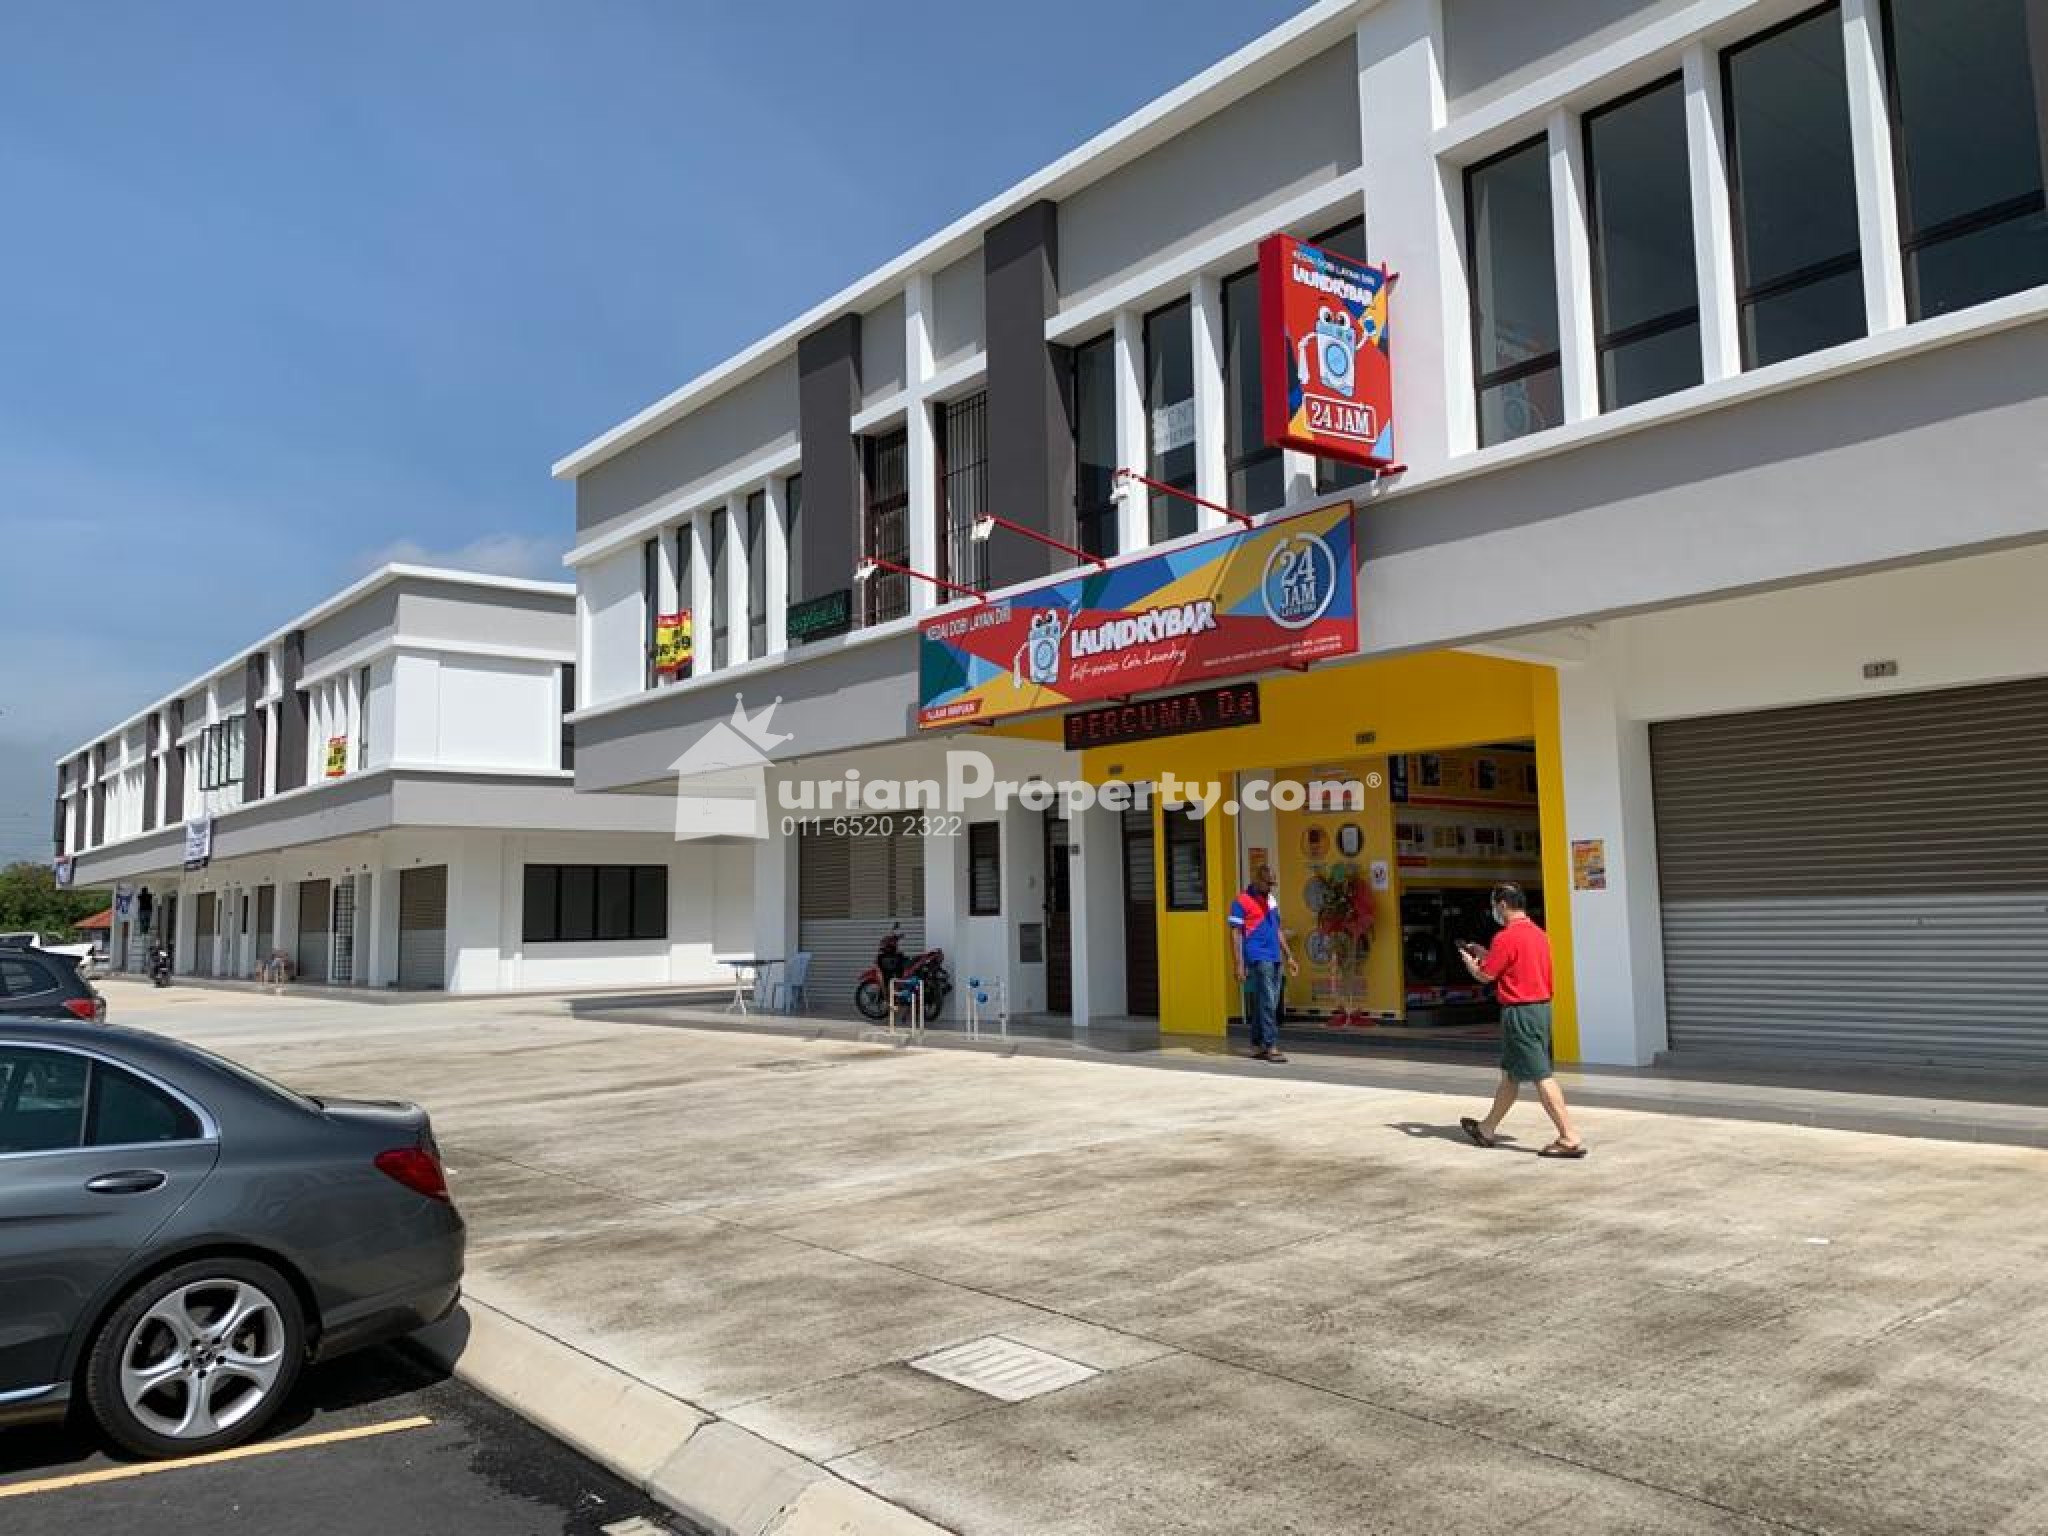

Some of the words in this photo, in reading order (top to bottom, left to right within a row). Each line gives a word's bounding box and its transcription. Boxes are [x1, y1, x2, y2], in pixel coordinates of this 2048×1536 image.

[1311, 401, 1333, 428] 24
[1335, 404, 1371, 435] JAM
[1280, 545, 1316, 588] 24
[1281, 582, 1316, 611] JAM
[1071, 600, 1217, 659] LAUNDRYBAR
[1071, 697, 1201, 742] PERCUMA
